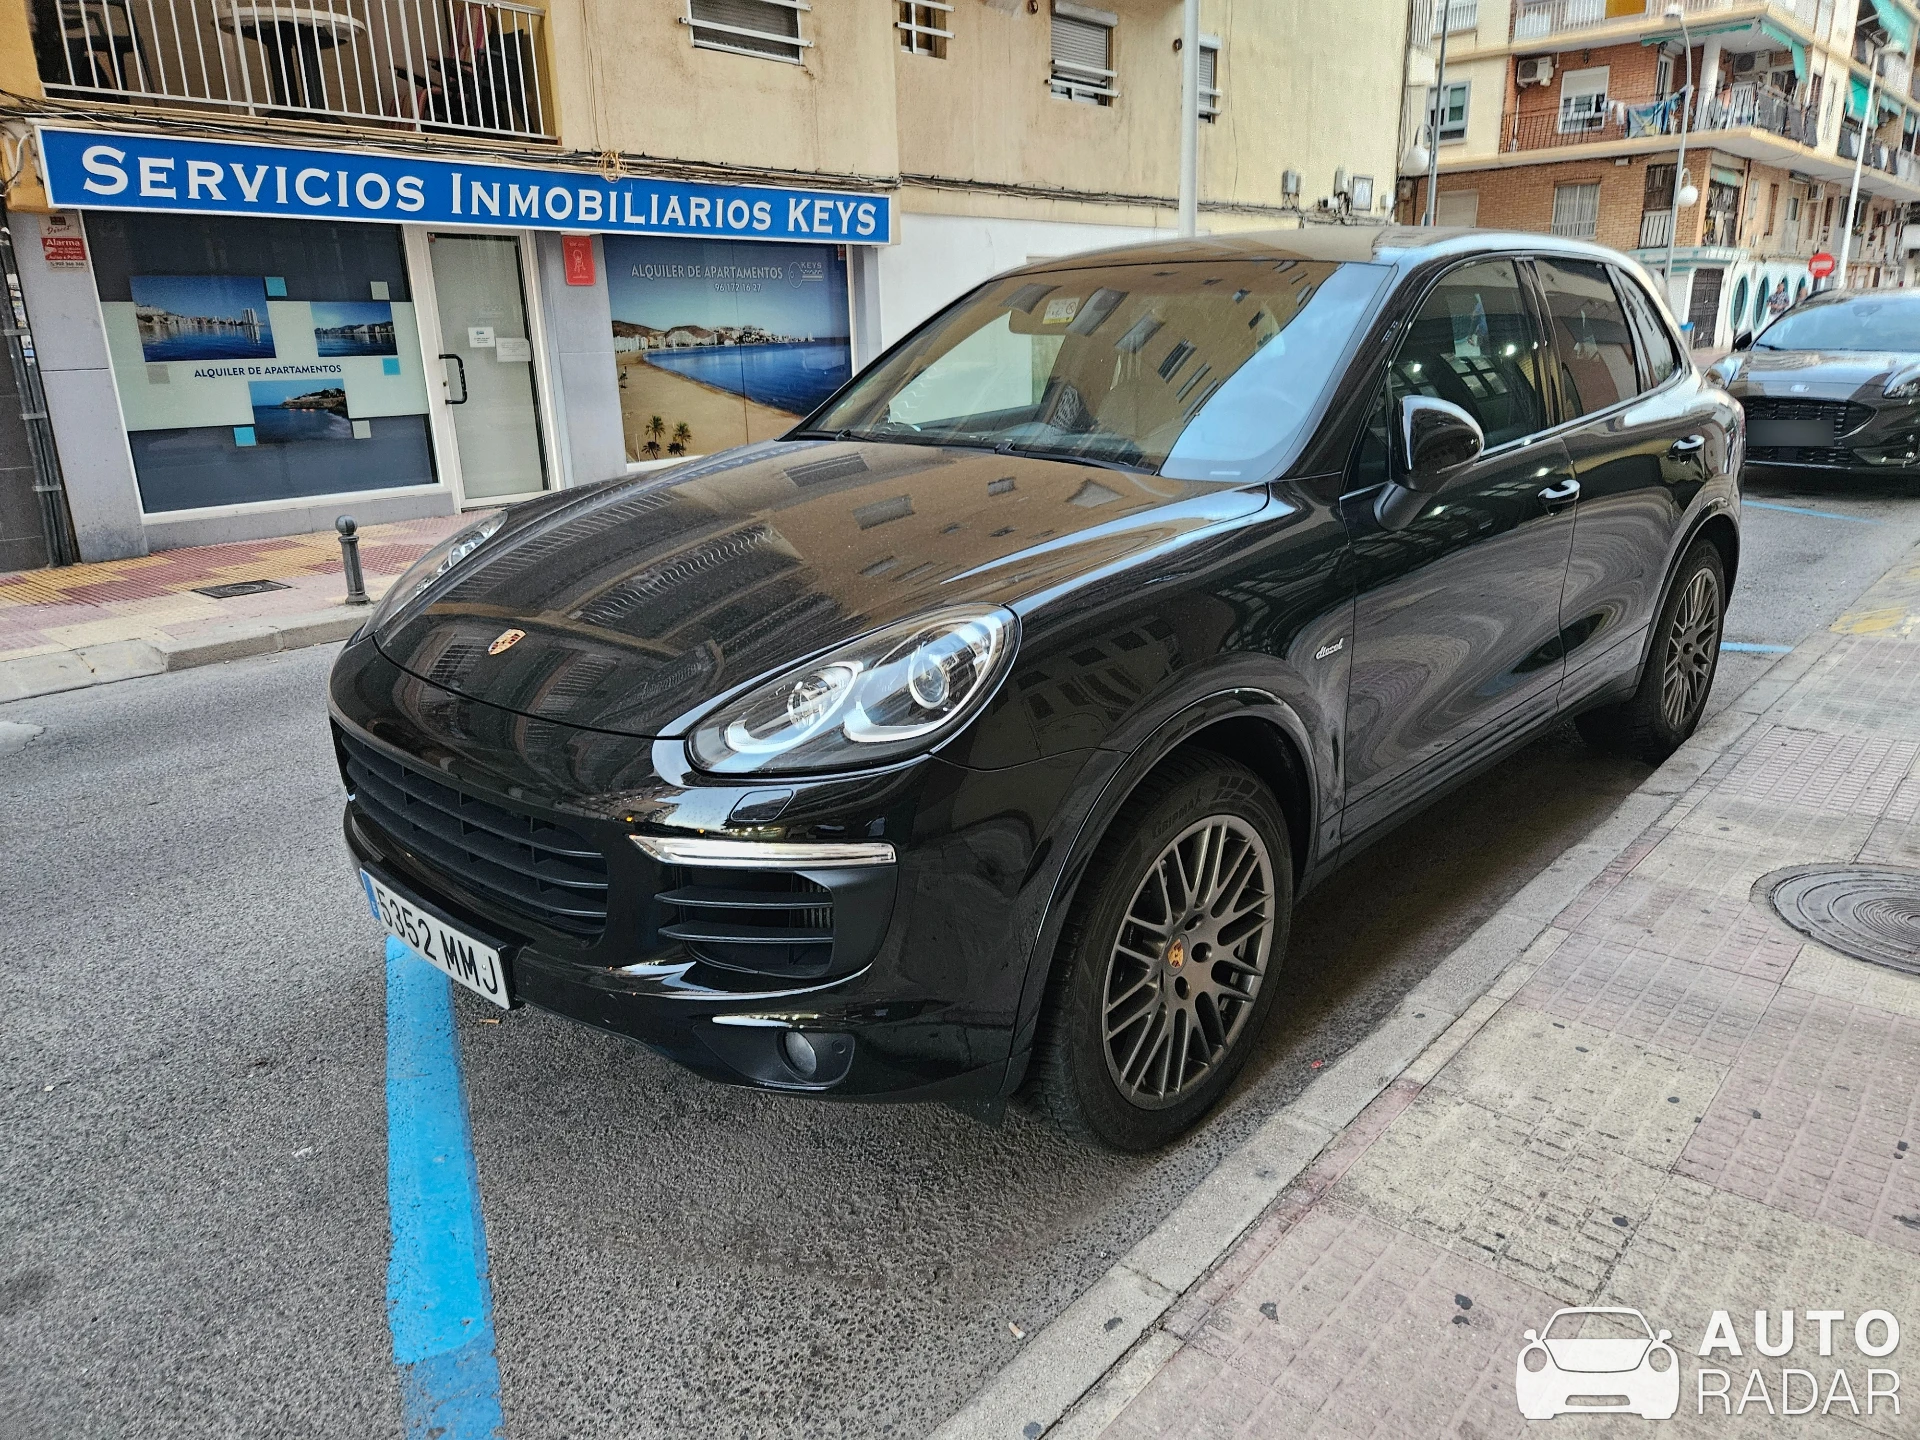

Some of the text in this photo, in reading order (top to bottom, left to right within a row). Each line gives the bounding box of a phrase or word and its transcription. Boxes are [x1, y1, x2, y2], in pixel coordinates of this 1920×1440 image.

[788, 198, 877, 236] KEYS
[631, 264, 783, 280] ALQUILER DE APARTAMENTOS
[801, 261, 822, 269] KEYS
[715, 283, 762, 292] 96 172 16 27
[194, 364, 342, 378] ALQUILER DE APARTAMENTOS
[376, 887, 498, 995] 5352 MMJ
